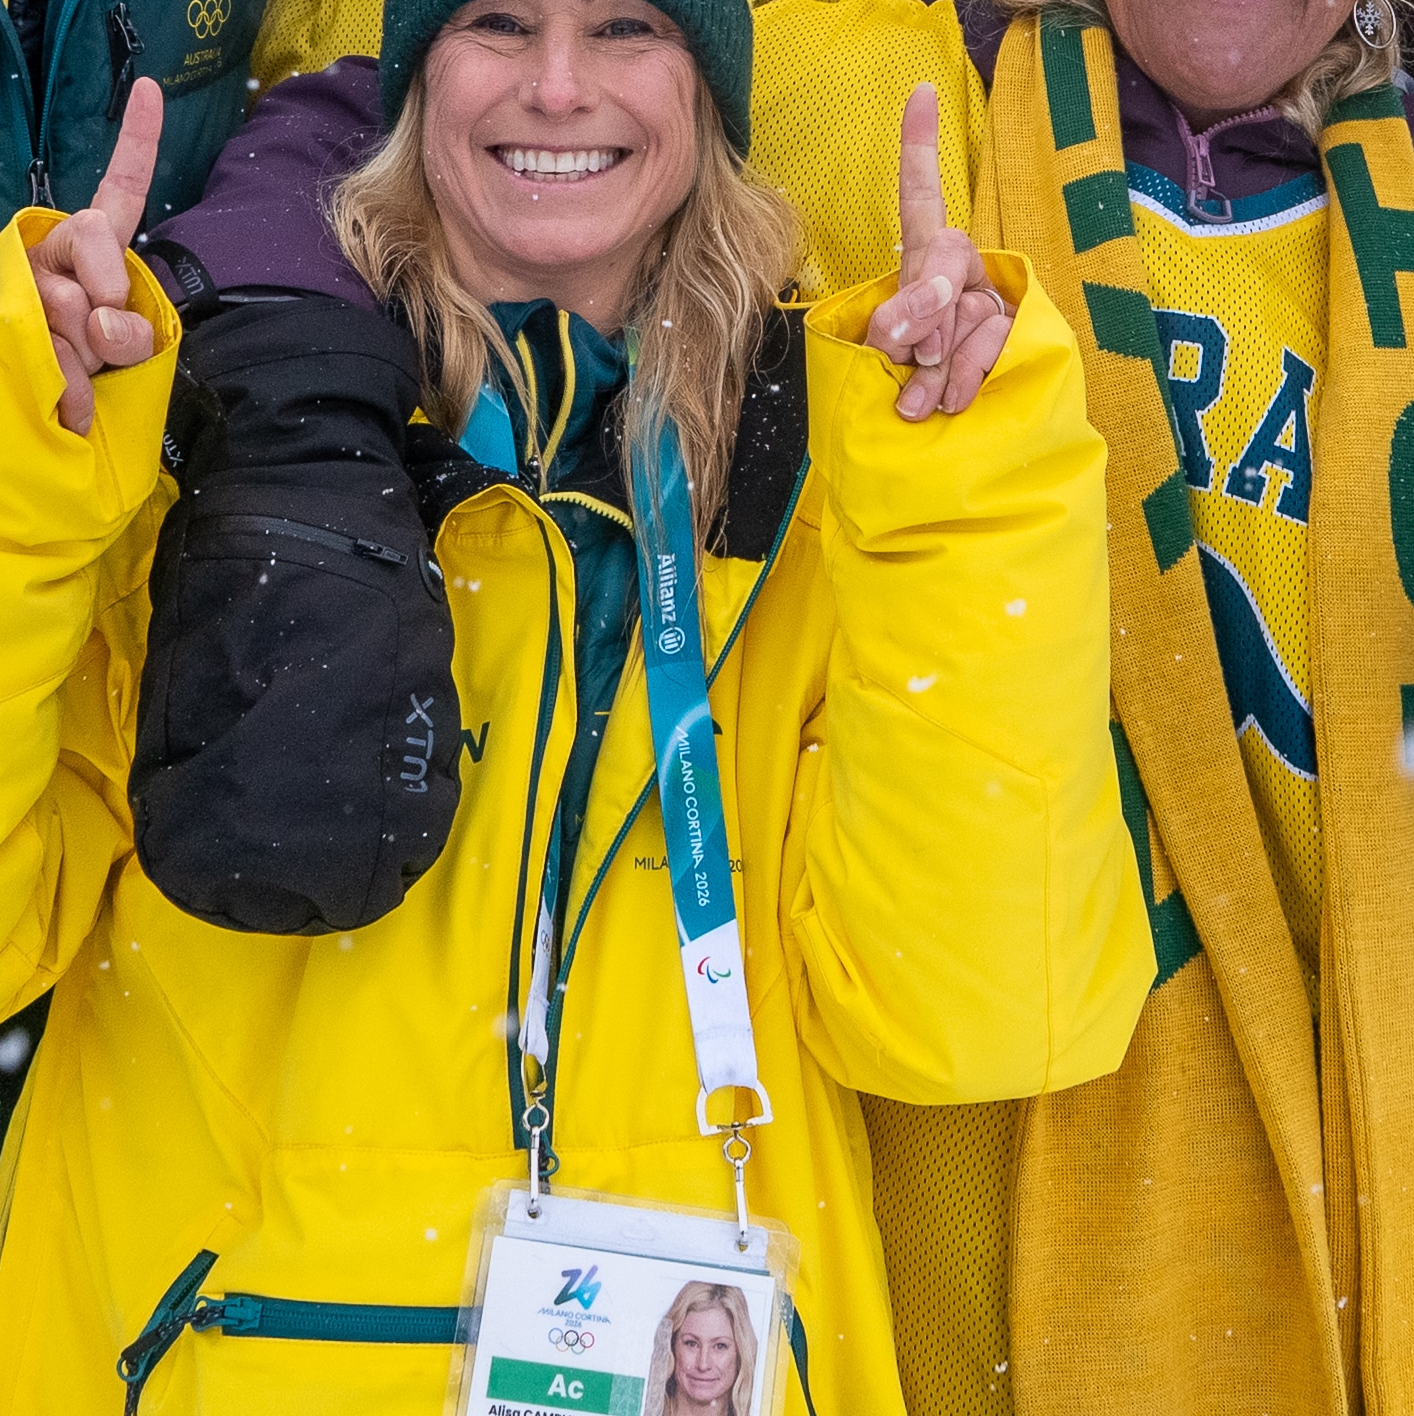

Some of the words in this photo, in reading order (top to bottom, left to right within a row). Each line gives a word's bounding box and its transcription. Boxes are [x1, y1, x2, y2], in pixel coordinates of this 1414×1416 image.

[657, 552, 678, 625] Allianz
[675, 725, 696, 795] MILANO
[685, 796, 705, 870] CORTINA
[634, 856, 669, 871] MILA
[729, 859, 744, 873] 20
[694, 872, 711, 907] 2026
[537, 1307, 575, 1319] MILANO
[546, 1373, 585, 1400] Ac
